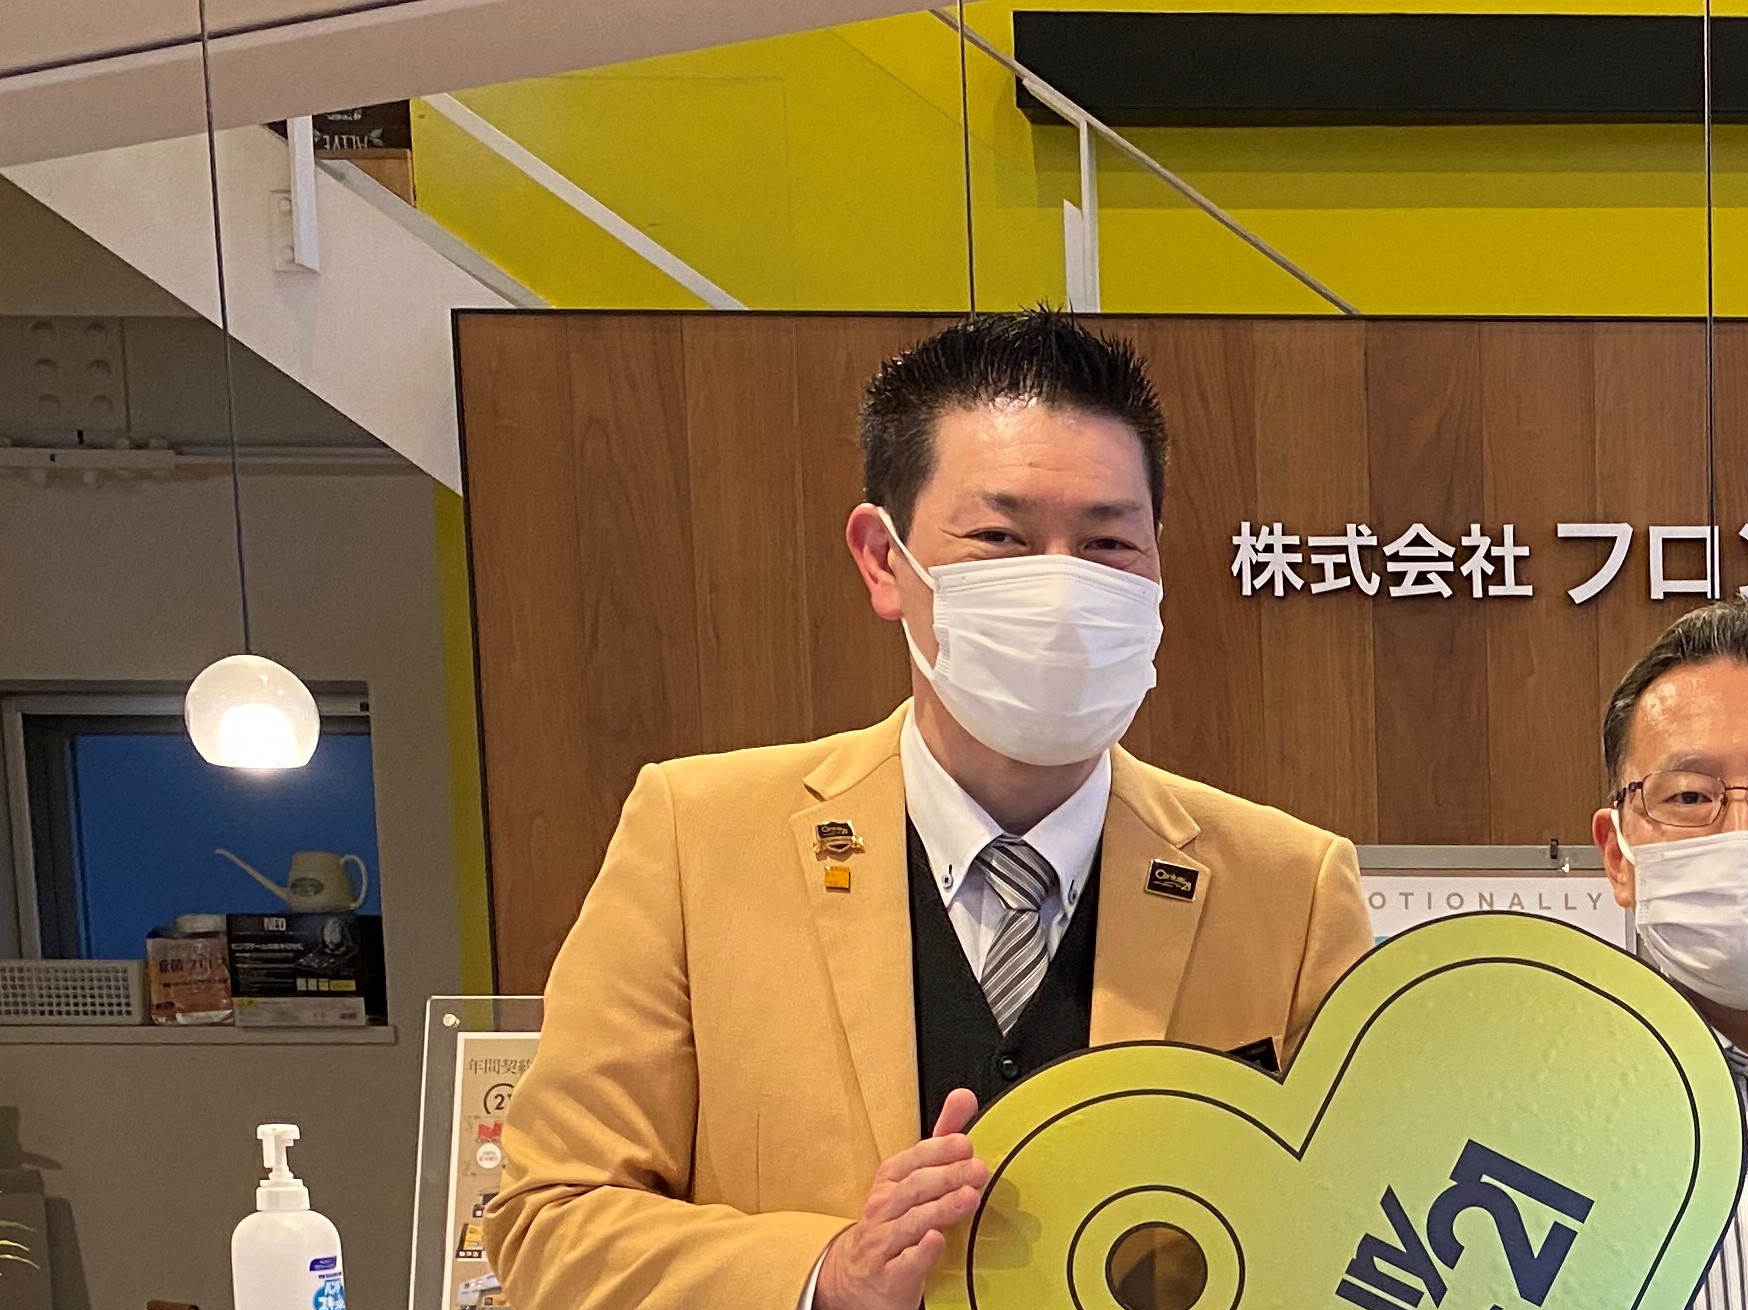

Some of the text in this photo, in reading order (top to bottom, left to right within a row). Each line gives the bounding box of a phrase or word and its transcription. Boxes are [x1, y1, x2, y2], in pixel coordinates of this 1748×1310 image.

[1232, 521, 1533, 600] 株式会社
[263, 917, 287, 932] NEO
[1368, 891, 1603, 911] OTIONALLY
[1426, 1139, 1595, 1308] 21
